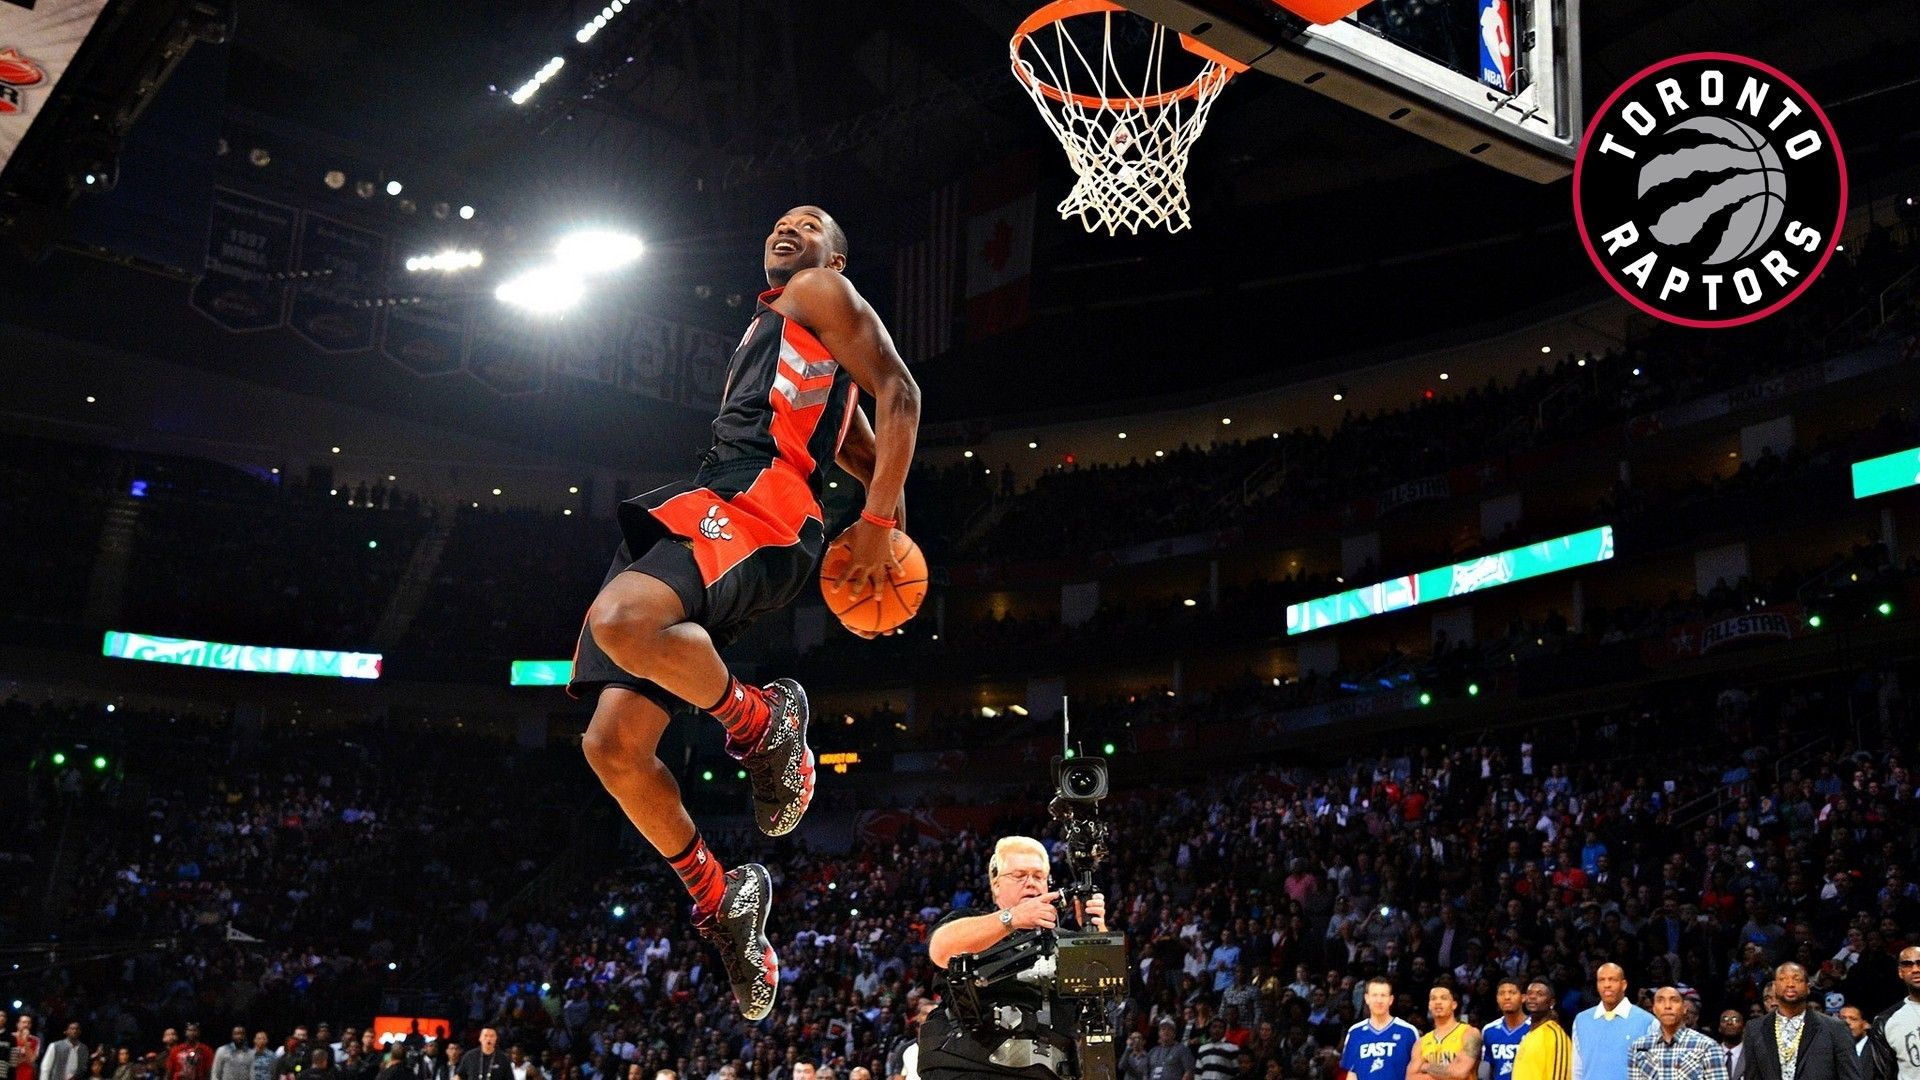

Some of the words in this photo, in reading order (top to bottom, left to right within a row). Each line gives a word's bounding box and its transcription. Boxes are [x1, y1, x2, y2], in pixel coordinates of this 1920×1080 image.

[1484, 67, 1502, 88] NBA
[1703, 614, 1788, 648] ALL-STAR
[1360, 1041, 1397, 1059] EAST
